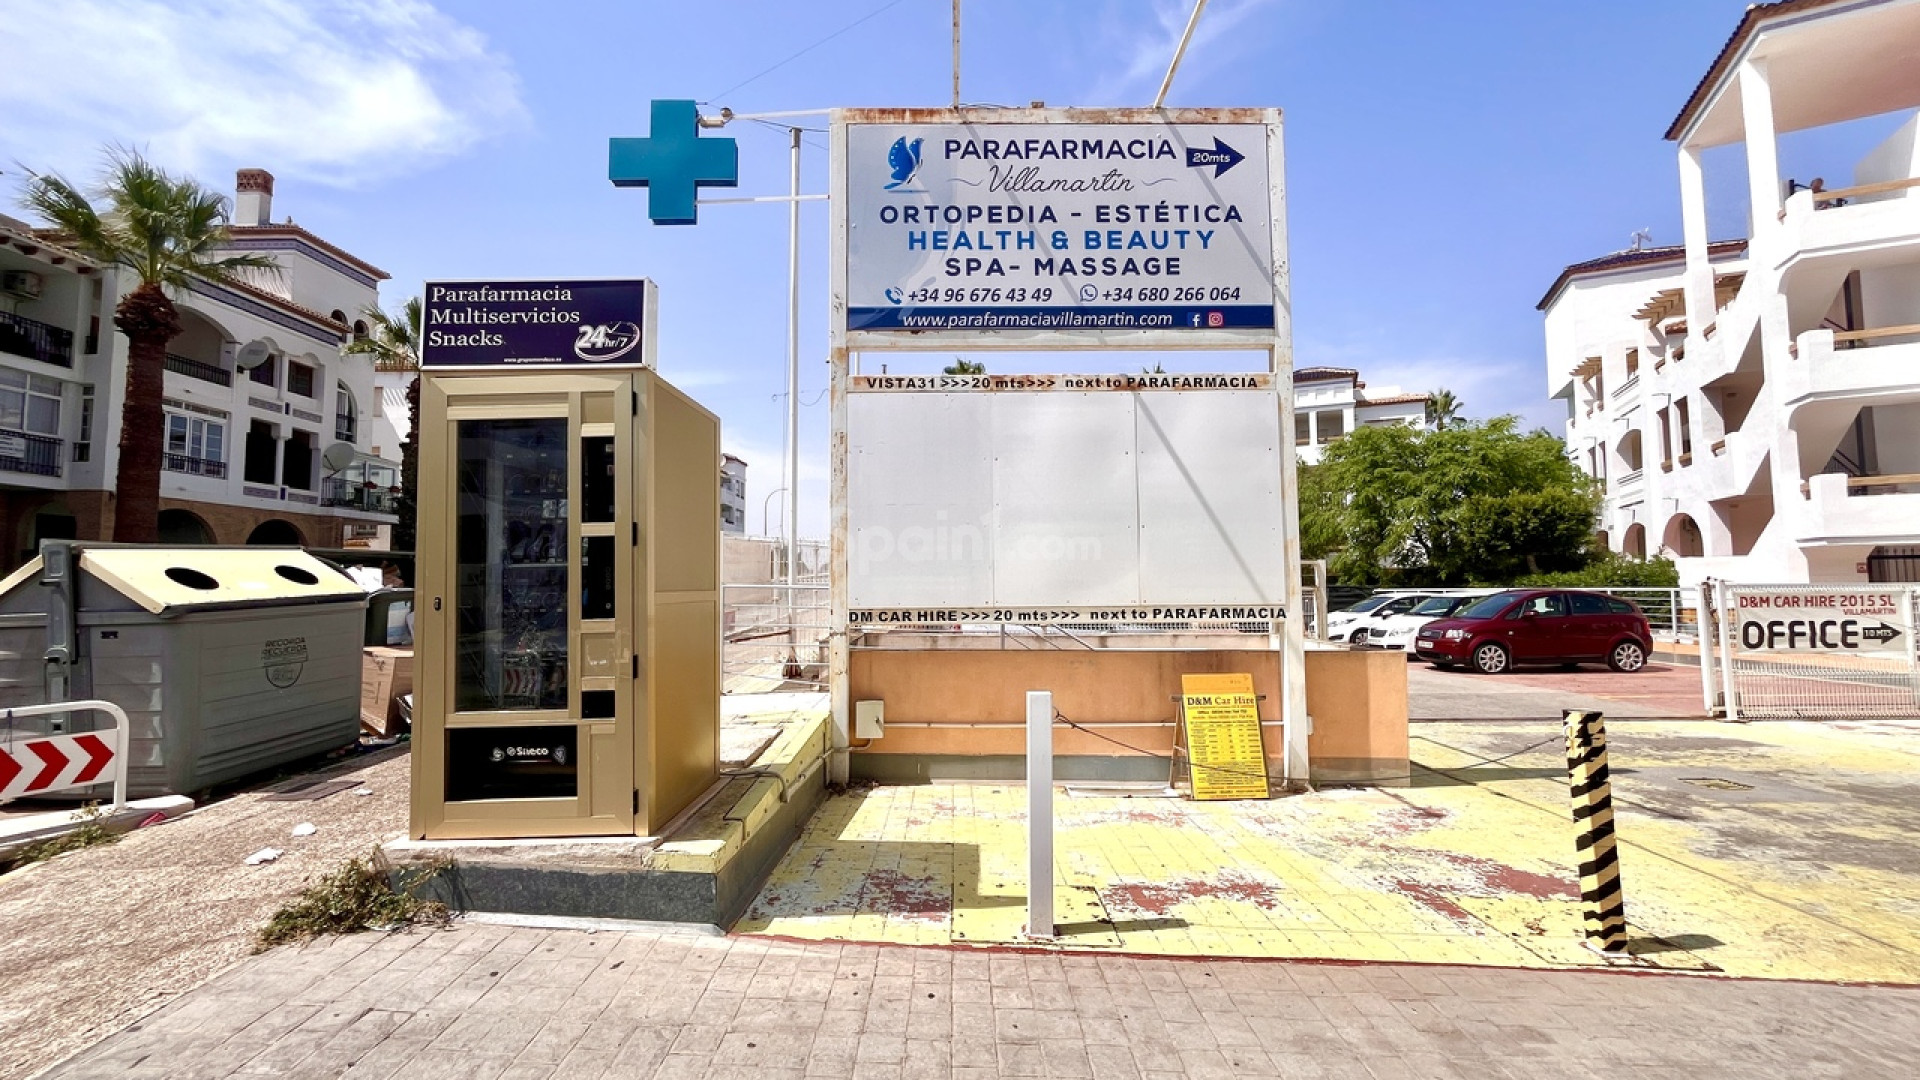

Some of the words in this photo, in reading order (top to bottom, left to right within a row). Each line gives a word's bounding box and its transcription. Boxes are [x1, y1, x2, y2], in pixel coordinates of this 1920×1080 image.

[944, 139, 1176, 160] PARAFARMACIA
[1191, 152, 1231, 165] 20mts
[880, 205, 1058, 224] ORTOPEDIA
[1096, 201, 1243, 223] ESTÉTICA
[908, 231, 1035, 250] HEALTH
[1051, 231, 1069, 250] &
[1084, 230, 1216, 250] BEAUTY
[1034, 258, 1181, 276] MASSAGE
[431, 286, 572, 302] Parafarmacia
[908, 288, 939, 303] +34
[944, 288, 965, 303] 96
[969, 288, 1001, 303] 676
[1005, 288, 1028, 303] 43
[1031, 288, 1052, 303] 49
[1102, 288, 1134, 303] +34
[1138, 287, 1170, 302] 680
[1174, 287, 1205, 302] 266
[1209, 287, 1240, 302] 064
[429, 307, 580, 324] Multiservicios
[903, 312, 1172, 329] www.parafarmaciavillamartin.com
[429, 330, 503, 346] Snacks
[867, 378, 935, 388] VISTA31
[1065, 378, 1102, 389] next
[1106, 378, 1122, 389] to
[1126, 377, 1258, 389] PARAFARMACIA
[1740, 597, 1770, 608] D&M
[1774, 596, 1800, 608] CAR
[1804, 596, 1835, 607] HIRE
[1840, 595, 1875, 607] 2015
[1880, 594, 1895, 606] SL
[849, 611, 873, 622] DM
[878, 611, 913, 622] CAR
[917, 611, 958, 621] HIRE
[1090, 609, 1127, 620] next
[1131, 609, 1147, 620] to
[1152, 609, 1287, 620] PARAFARMACIA
[1742, 620, 1859, 649] OFFICE
[1187, 697, 1212, 705] D&M
